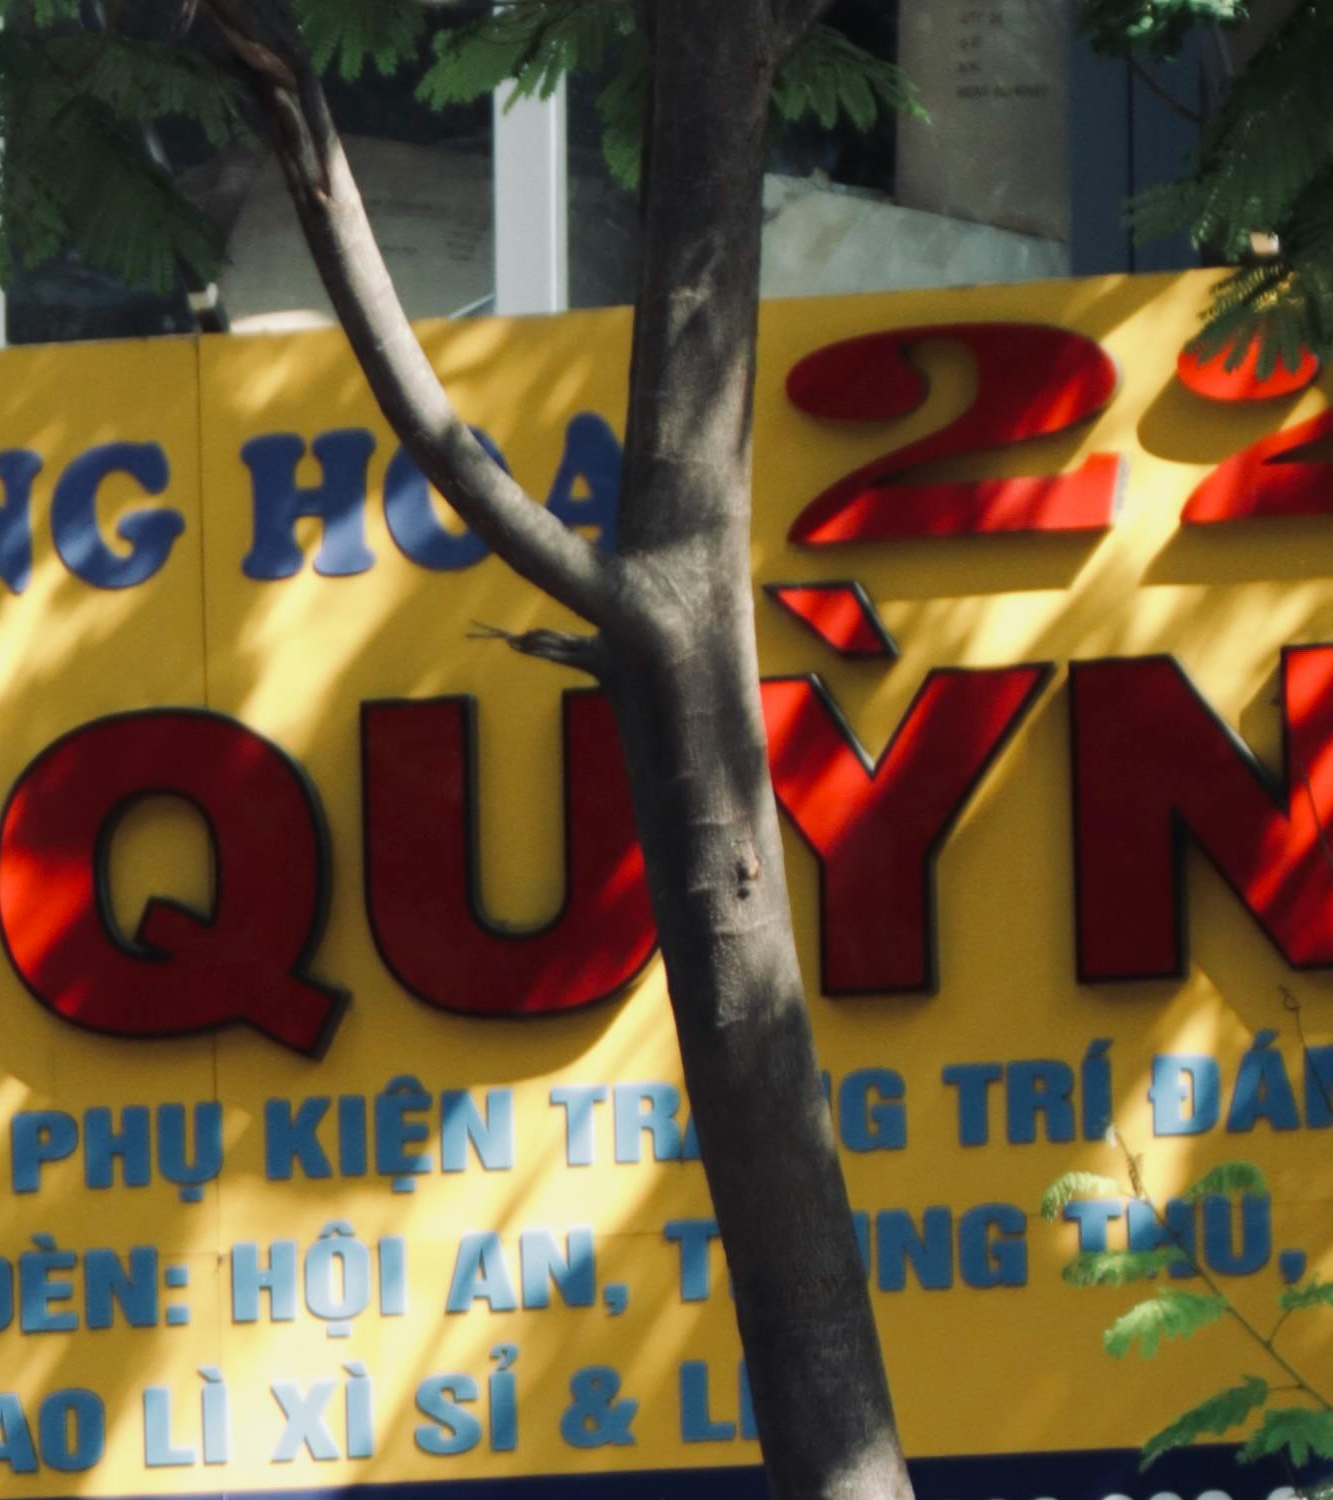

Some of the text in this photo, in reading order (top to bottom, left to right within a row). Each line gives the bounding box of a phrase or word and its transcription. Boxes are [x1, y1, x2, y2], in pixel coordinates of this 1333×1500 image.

[239, 412, 625, 582] HOA
[11, 1100, 225, 1202] PHỤ
[264, 1075, 514, 1194] KIỆN
[549, 1066, 908, 1169] TRG
[943, 1038, 1113, 1147] TRÍ
[1148, 1030, 1333, 1136] ĐÁ
[229, 1222, 410, 1337] HỘI
[448, 1229, 630, 1320] AN,
[665, 1203, 1029, 1302] TNG
[142, 1362, 231, 1470] LÌ
[270, 1359, 375, 1461] XÌ
[414, 1344, 519, 1457] SỈ
[559, 1364, 639, 1449] &
